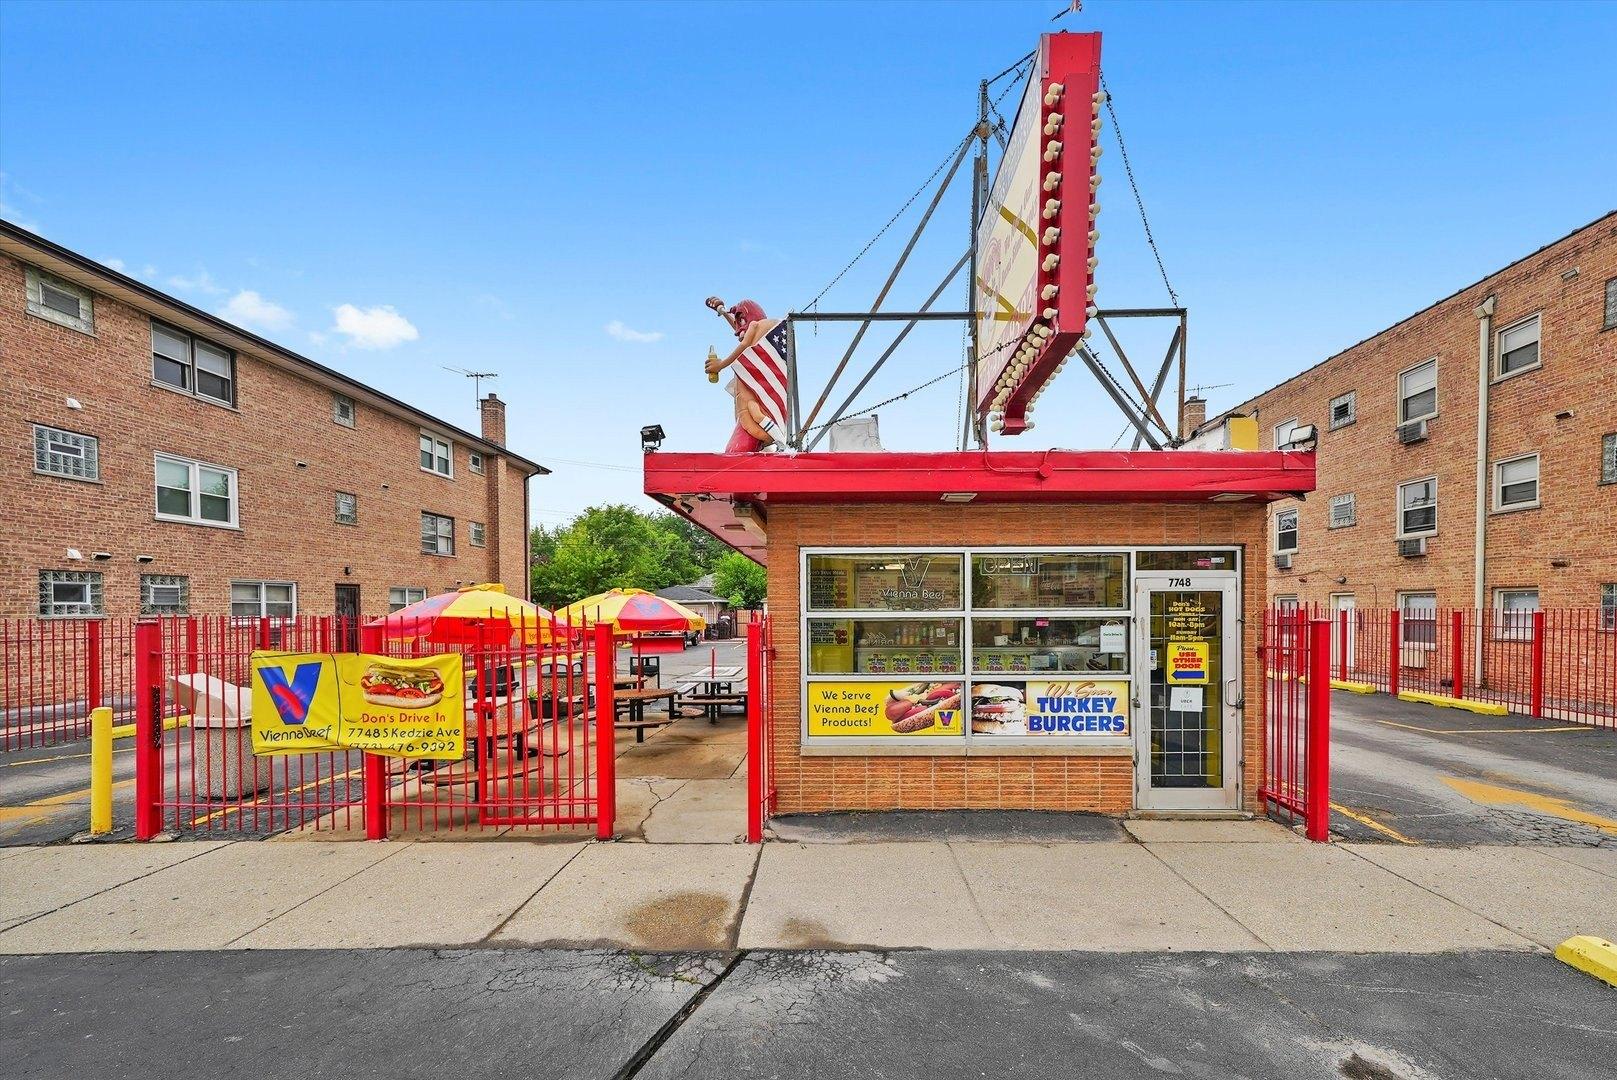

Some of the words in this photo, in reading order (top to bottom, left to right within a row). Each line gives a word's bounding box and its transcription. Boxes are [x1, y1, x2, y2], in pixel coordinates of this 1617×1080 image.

[1168, 578, 1191, 587] 7748
[881, 588, 918, 599] Vienna
[922, 589, 946, 600] Beef
[822, 691, 838, 700] We
[842, 691, 871, 700] Serve
[813, 704, 851, 713] Vienna
[854, 704, 880, 715] Beef
[1036, 697, 1117, 713] TURKEY
[361, 713, 395, 723] Don's
[399, 712, 430, 723] Drive
[435, 712, 446, 722] In
[822, 717, 872, 727] Products!
[1028, 715, 1125, 731] BURGERS
[391, 728, 434, 738] Kedzie
[436, 727, 460, 737] Ave
